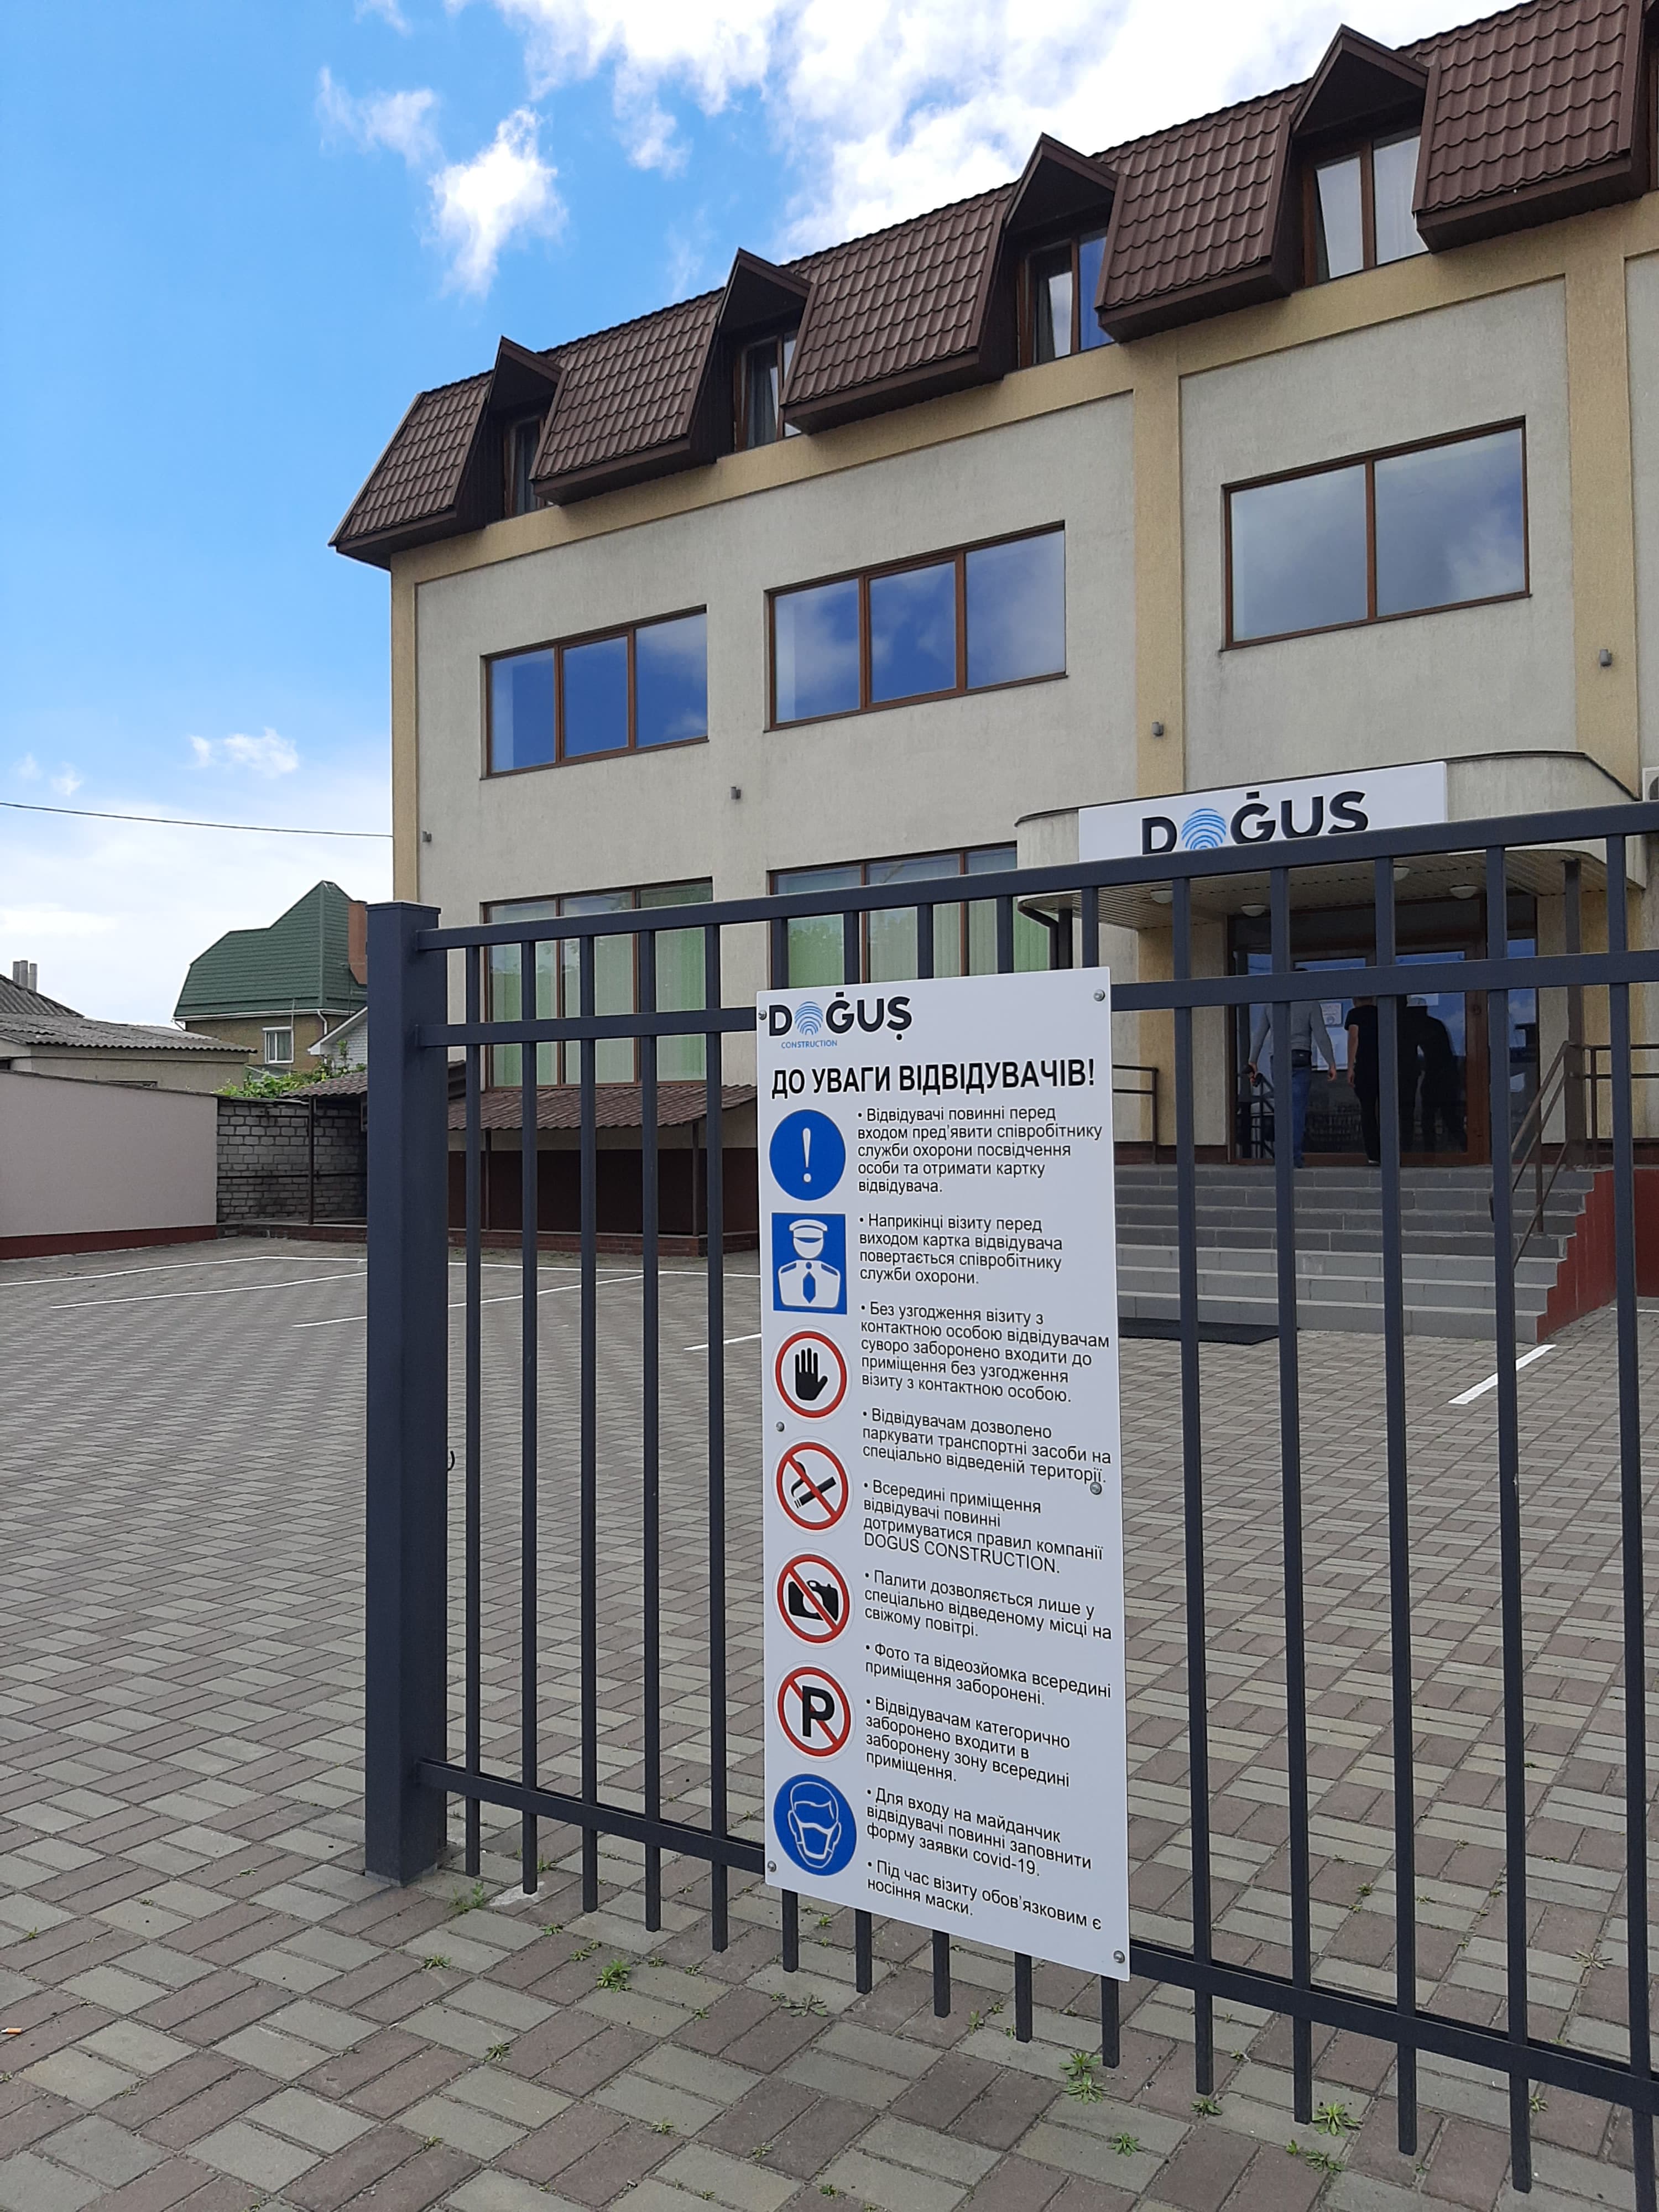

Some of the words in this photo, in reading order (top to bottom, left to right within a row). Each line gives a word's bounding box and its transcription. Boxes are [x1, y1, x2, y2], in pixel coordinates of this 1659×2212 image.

[781, 1040, 837, 1048] CONSTRUCTION
[771, 1069, 805, 1099] ДО
[811, 1066, 890, 1094] УВАГИ
[899, 1058, 1094, 1096] ВІДВІДУВАЧІВ!
[867, 1107, 944, 1125] Відвідувачі
[949, 1105, 1005, 1120] повинні
[1010, 1108, 1056, 1123] перед
[858, 1128, 907, 1141] входом
[997, 1123, 1102, 1141] співробітнику
[858, 1142, 909, 1160] служби
[913, 1146, 972, 1160] охорони
[977, 1142, 1071, 1159] посвідчення
[858, 1160, 899, 1174] особи
[903, 1164, 919, 1175] та
[923, 1164, 992, 1178] отримати
[997, 1164, 1045, 1178] картку
[859, 1178, 942, 1196] відвідувача.
[869, 1213, 943, 1230] Наприкінці
[948, 1214, 992, 1233] візиту
[997, 1219, 1042, 1234] перед
[859, 1234, 918, 1248] виходом
[923, 1235, 970, 1250] картка
[975, 1234, 1062, 1253] відвідувача
[860, 1251, 954, 1266] повертається
[959, 1251, 1062, 1272] співробітнику
[860, 1267, 911, 1284] служби
[915, 1271, 979, 1286] охорони.
[870, 1301, 894, 1316] Без
[899, 1306, 981, 1321] узгодження
[986, 1308, 1031, 1328] візиту
[1036, 1313, 1044, 1325] з
[861, 1321, 942, 1337] контактною
[946, 1325, 1002, 1340] особою
[1007, 1328, 1109, 1348] відвідувачам
[861, 1339, 909, 1355] суворо
[913, 1340, 1000, 1359] заборонено
[1005, 1349, 1067, 1365] входити
[1071, 1354, 1092, 1368] до
[862, 1356, 946, 1374] приміщення
[951, 1360, 975, 1376] без
[980, 1366, 1068, 1383] узгодження
[862, 1371, 903, 1391] візиту
[907, 1378, 914, 1389] з
[919, 1379, 1003, 1396] контактною
[1008, 1385, 1071, 1402] особою.
[872, 1407, 966, 1430] Відвідувачам
[970, 1421, 1052, 1439] дозволено
[863, 1428, 933, 1445] паркувати
[937, 1436, 1027, 1456] транспортні
[1031, 1445, 1087, 1462] засоби
[1092, 1451, 1111, 1464] на
[863, 1446, 942, 1464] спеціально
[946, 1452, 1025, 1474] відведеній
[1029, 1464, 1106, 1484] території.
[864, 1497, 939, 1519] відвідувачі
[944, 1510, 1000, 1527] повинні
[873, 1479, 945, 1502] Всередині
[950, 1492, 1041, 1514] приміщення
[863, 1517, 972, 1542] дотримуватися
[977, 1532, 1031, 1551] правил
[1036, 1541, 1104, 1561] компанії
[864, 1532, 920, 1553] DOGUS
[924, 1541, 1060, 1574] CONSTRUCTION.
[874, 1569, 926, 1591] Палити
[930, 1582, 1033, 1608] дозволяється
[1037, 1598, 1081, 1615] лише
[1086, 1605, 1094, 1621] у
[864, 1589, 944, 1612] спеціально
[948, 1600, 1045, 1632] відведеному
[1050, 1617, 1087, 1638] місці
[1093, 1626, 1112, 1640] на
[865, 1606, 921, 1630] свіжому
[925, 1618, 978, 1638] повітрі.
[865, 1662, 951, 1688] приміщення
[956, 1678, 1045, 1705] заборонені.
[875, 1643, 910, 1661] Фото
[914, 1652, 930, 1665] та
[934, 1654, 1027, 1683] відеозйомка
[1032, 1673, 1111, 1698] всередині
[865, 1716, 951, 1743] заборонено
[955, 1734, 1015, 1757] входити
[1021, 1747, 1029, 1759] в
[875, 1696, 971, 1729] Відвідувачам
[975, 1719, 1070, 1749] категорично
[866, 1734, 950, 1765] заборонену
[954, 1752, 988, 1773] зону
[992, 1760, 1069, 1787] всередині
[867, 1752, 957, 1782] приміщення.
[875, 1787, 903, 1806] Для
[908, 1798, 950, 1820] входу
[954, 1808, 972, 1823] на
[977, 1813, 1061, 1843] майданчик
[867, 1804, 943, 1834] відвідувачі
[948, 1825, 1005, 1849] повинні
[1010, 1840, 1091, 1870] заповнити
[867, 1822, 915, 1849] форму
[919, 1837, 968, 1859] заявки
[973, 1850, 1040, 1876] covid-19.
[868, 1879, 921, 1902] носіння
[925, 1893, 973, 1916] маски.
[877, 1859, 900, 1881] Під
[904, 1870, 930, 1886] час
[933, 1876, 978, 1901] візиту
[1092, 1918, 1102, 1930] є
